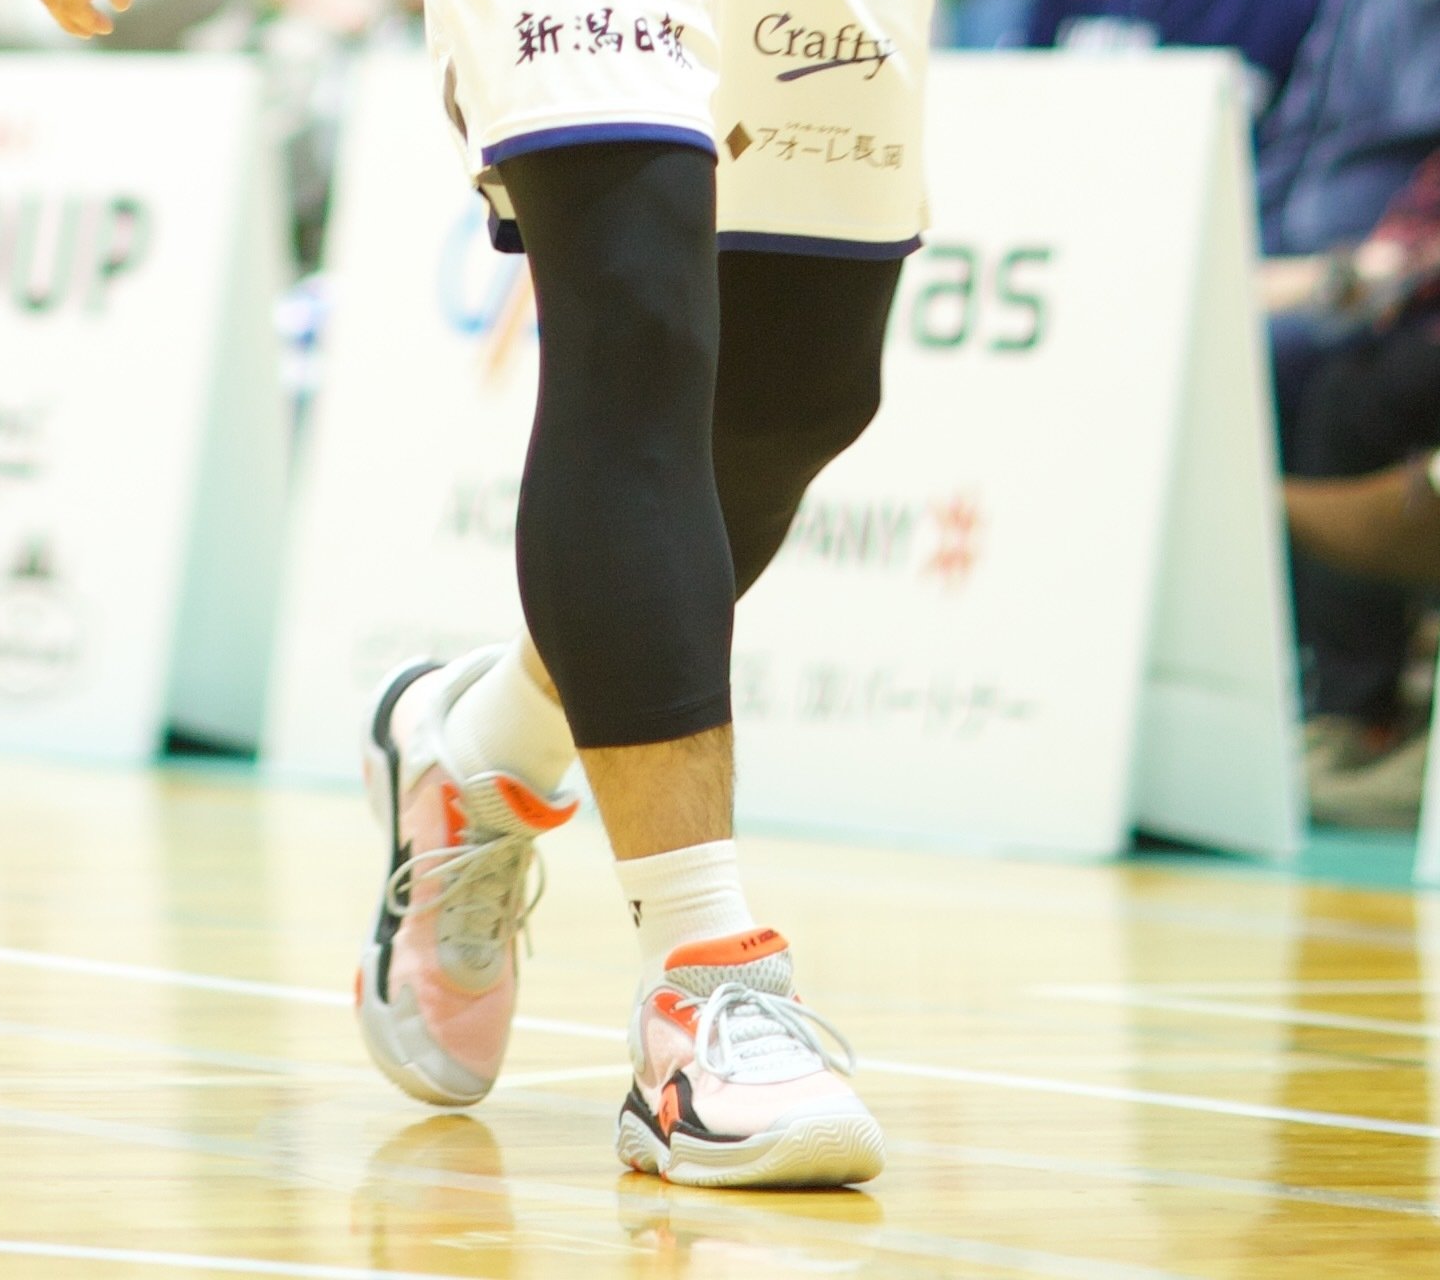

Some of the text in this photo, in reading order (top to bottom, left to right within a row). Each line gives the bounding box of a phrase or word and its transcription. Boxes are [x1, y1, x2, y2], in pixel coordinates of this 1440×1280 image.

[514, 7, 694, 71] 新潟日報
[753, 11, 896, 82] Crafty
